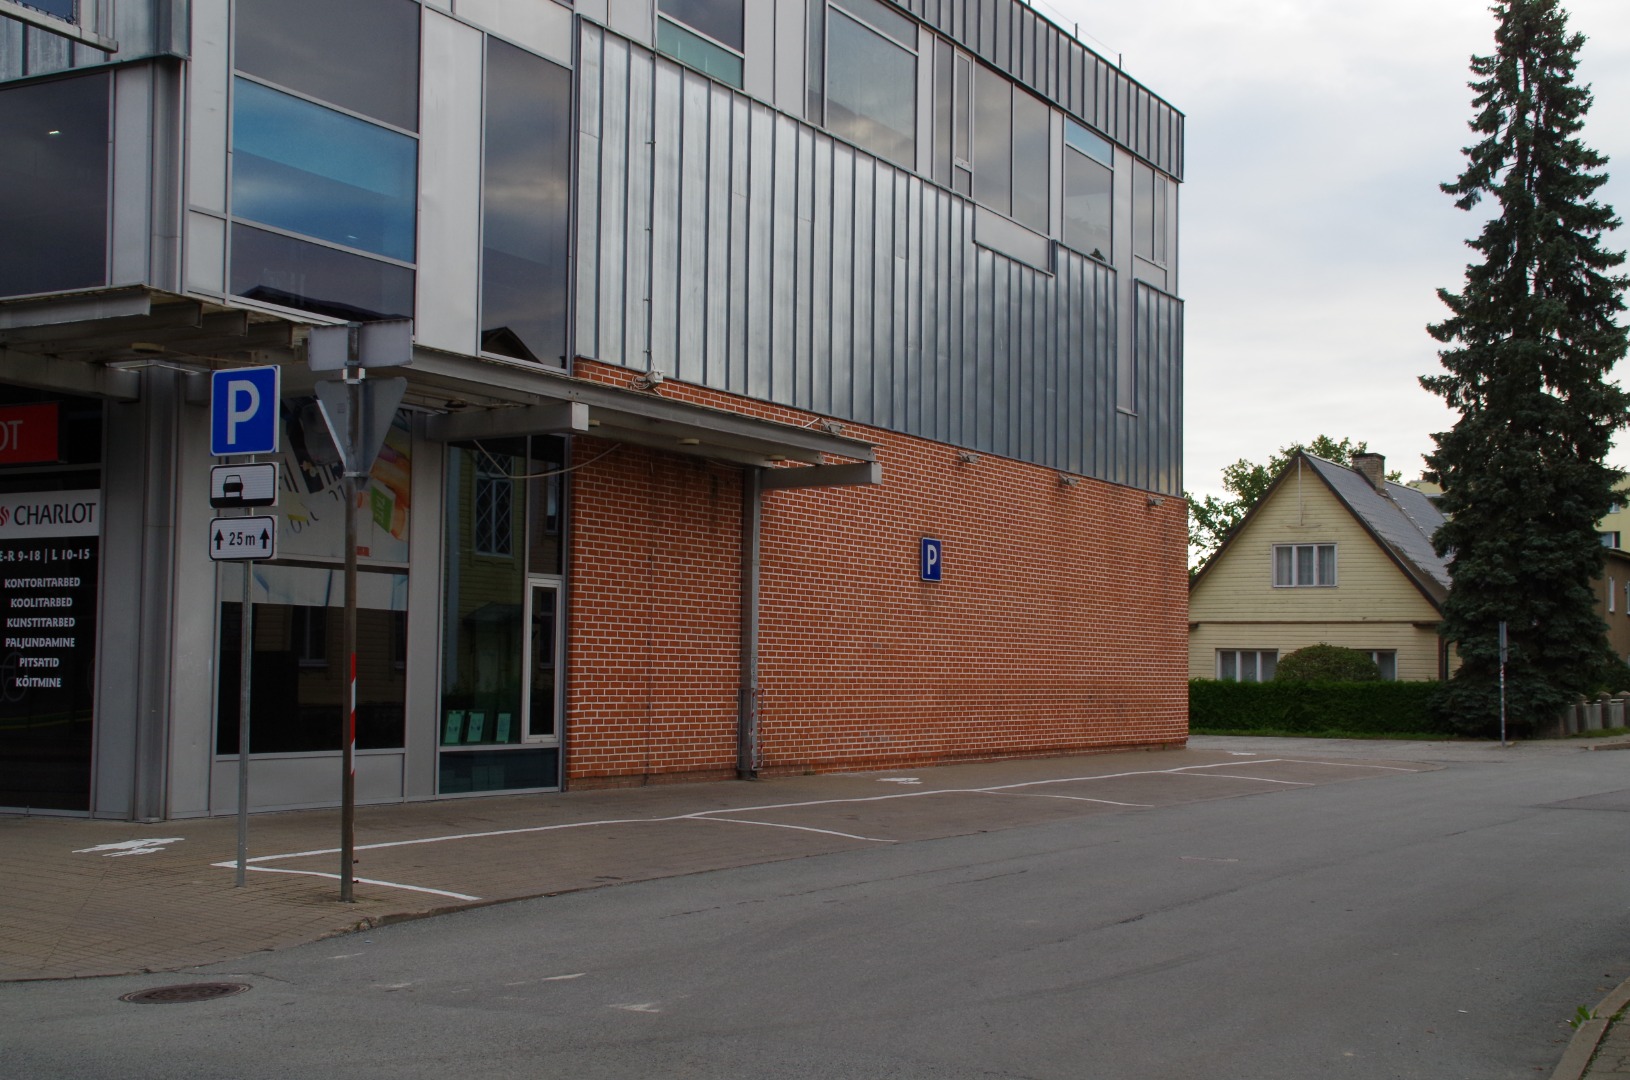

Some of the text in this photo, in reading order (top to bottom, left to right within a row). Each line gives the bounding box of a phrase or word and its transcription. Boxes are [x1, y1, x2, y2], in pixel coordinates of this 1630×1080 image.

[227, 380, 260, 445] P
[14, 502, 96, 526] CHARLOT
[17, 549, 41, 562] 9-18
[51, 549, 58, 561] L
[61, 549, 90, 560] 10-15
[927, 544, 938, 575] P
[4, 577, 80, 588] KONTORITARBED
[10, 597, 73, 608] KOOLITARBED
[6, 617, 76, 628] KUNSTITARBED
[5, 637, 75, 649] PALJUNDAMINE
[19, 657, 60, 668] PITSATID
[15, 675, 62, 688] KÕITMINE
